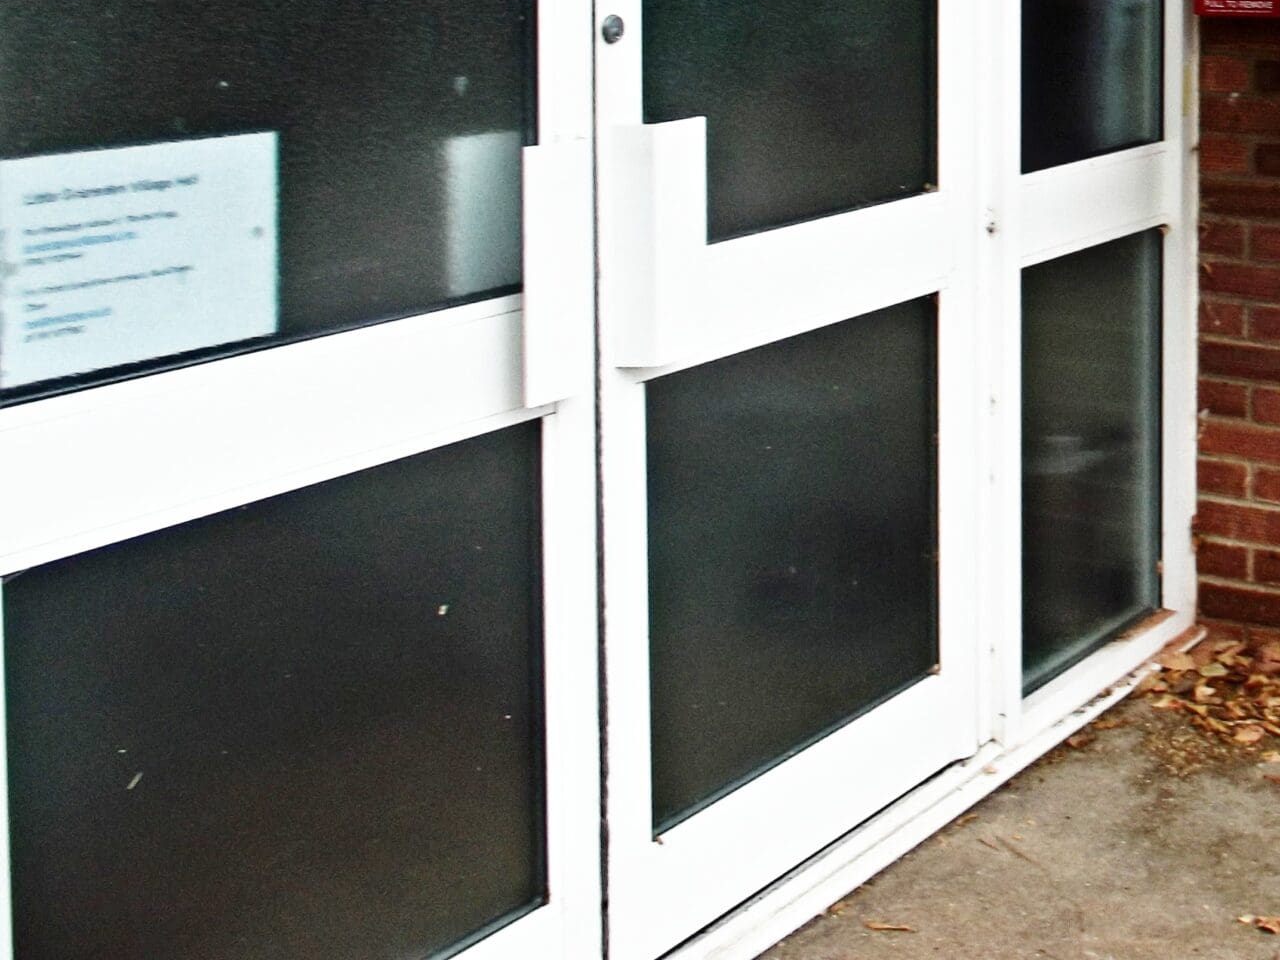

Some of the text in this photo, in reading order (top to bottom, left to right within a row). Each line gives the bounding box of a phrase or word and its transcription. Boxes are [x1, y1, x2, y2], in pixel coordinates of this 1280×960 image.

[1204, 0, 1273, 9] PULL TO REMOVE
